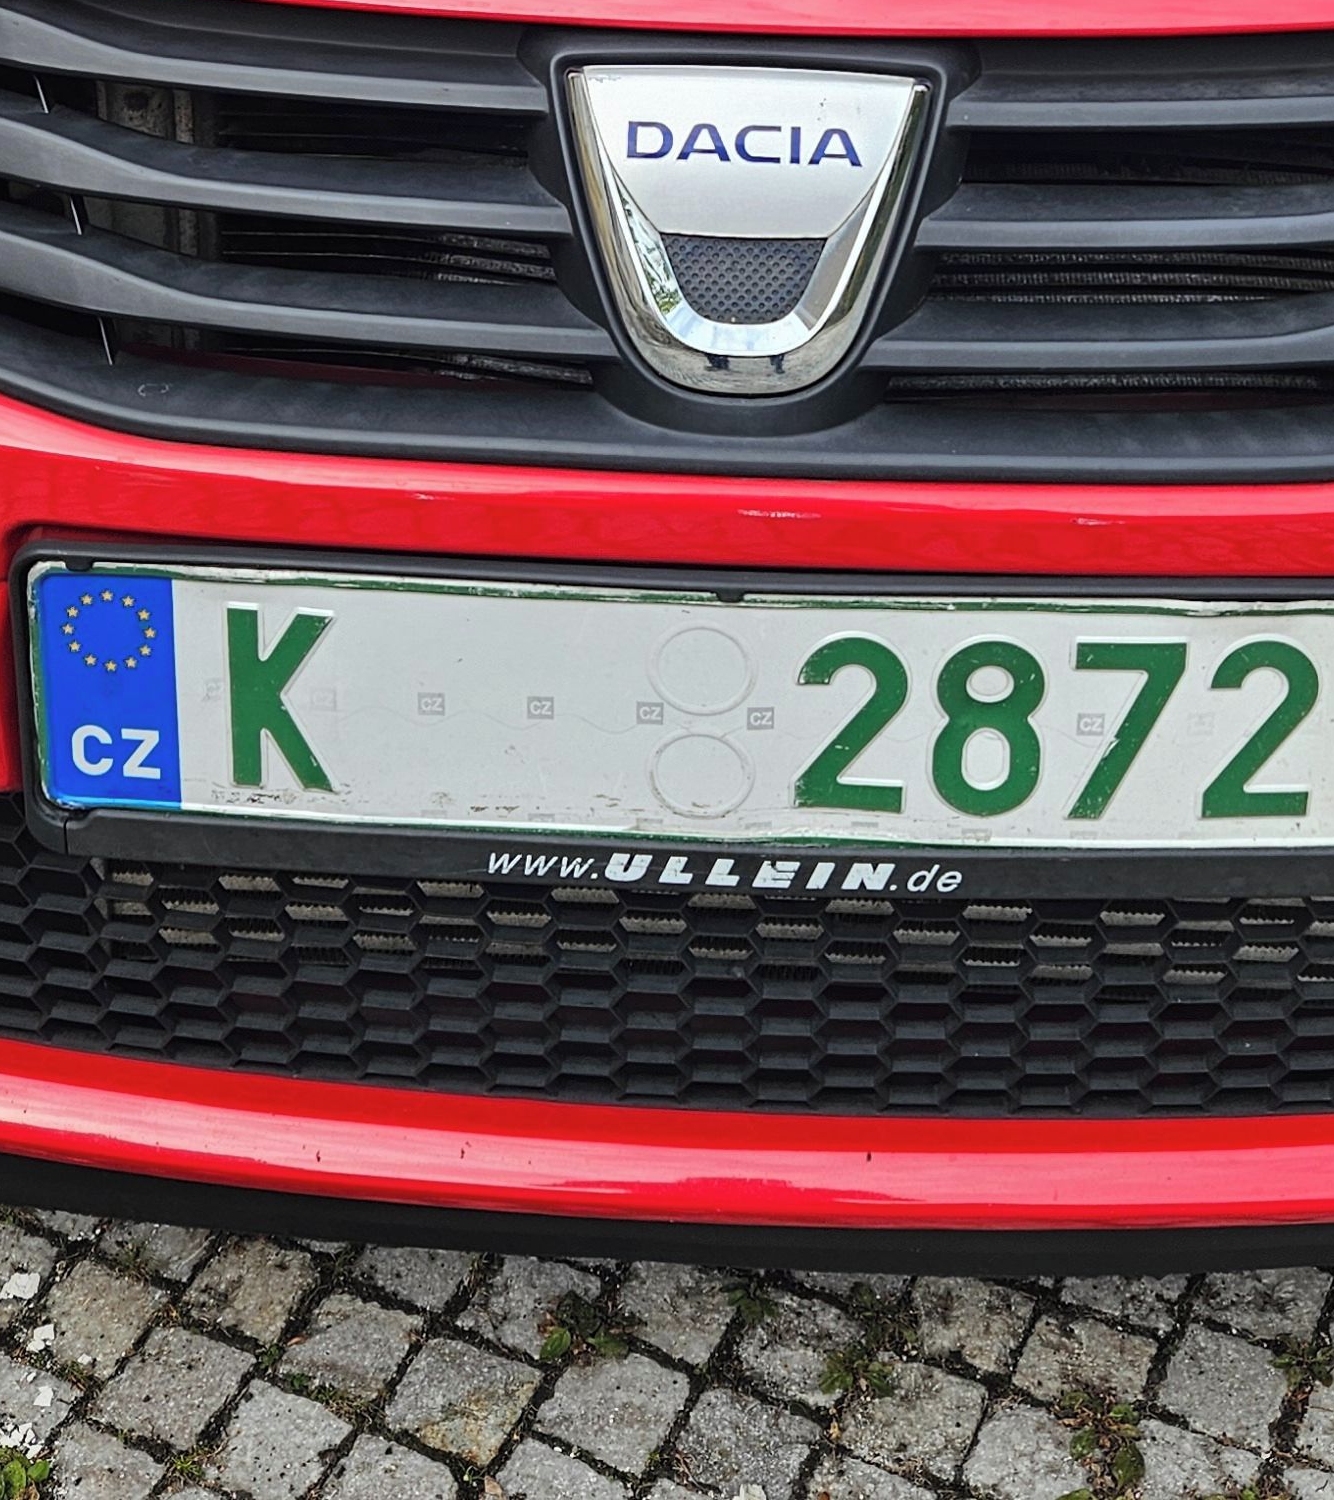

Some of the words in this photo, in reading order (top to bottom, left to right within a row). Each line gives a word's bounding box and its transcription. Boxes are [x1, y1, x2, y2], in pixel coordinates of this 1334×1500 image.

[626, 120, 863, 168] DACIA
[226, 604, 335, 791] K
[794, 635, 1321, 819] 2872
[70, 724, 162, 780] CZ
[487, 852, 963, 894] www.ULLEIN.de
